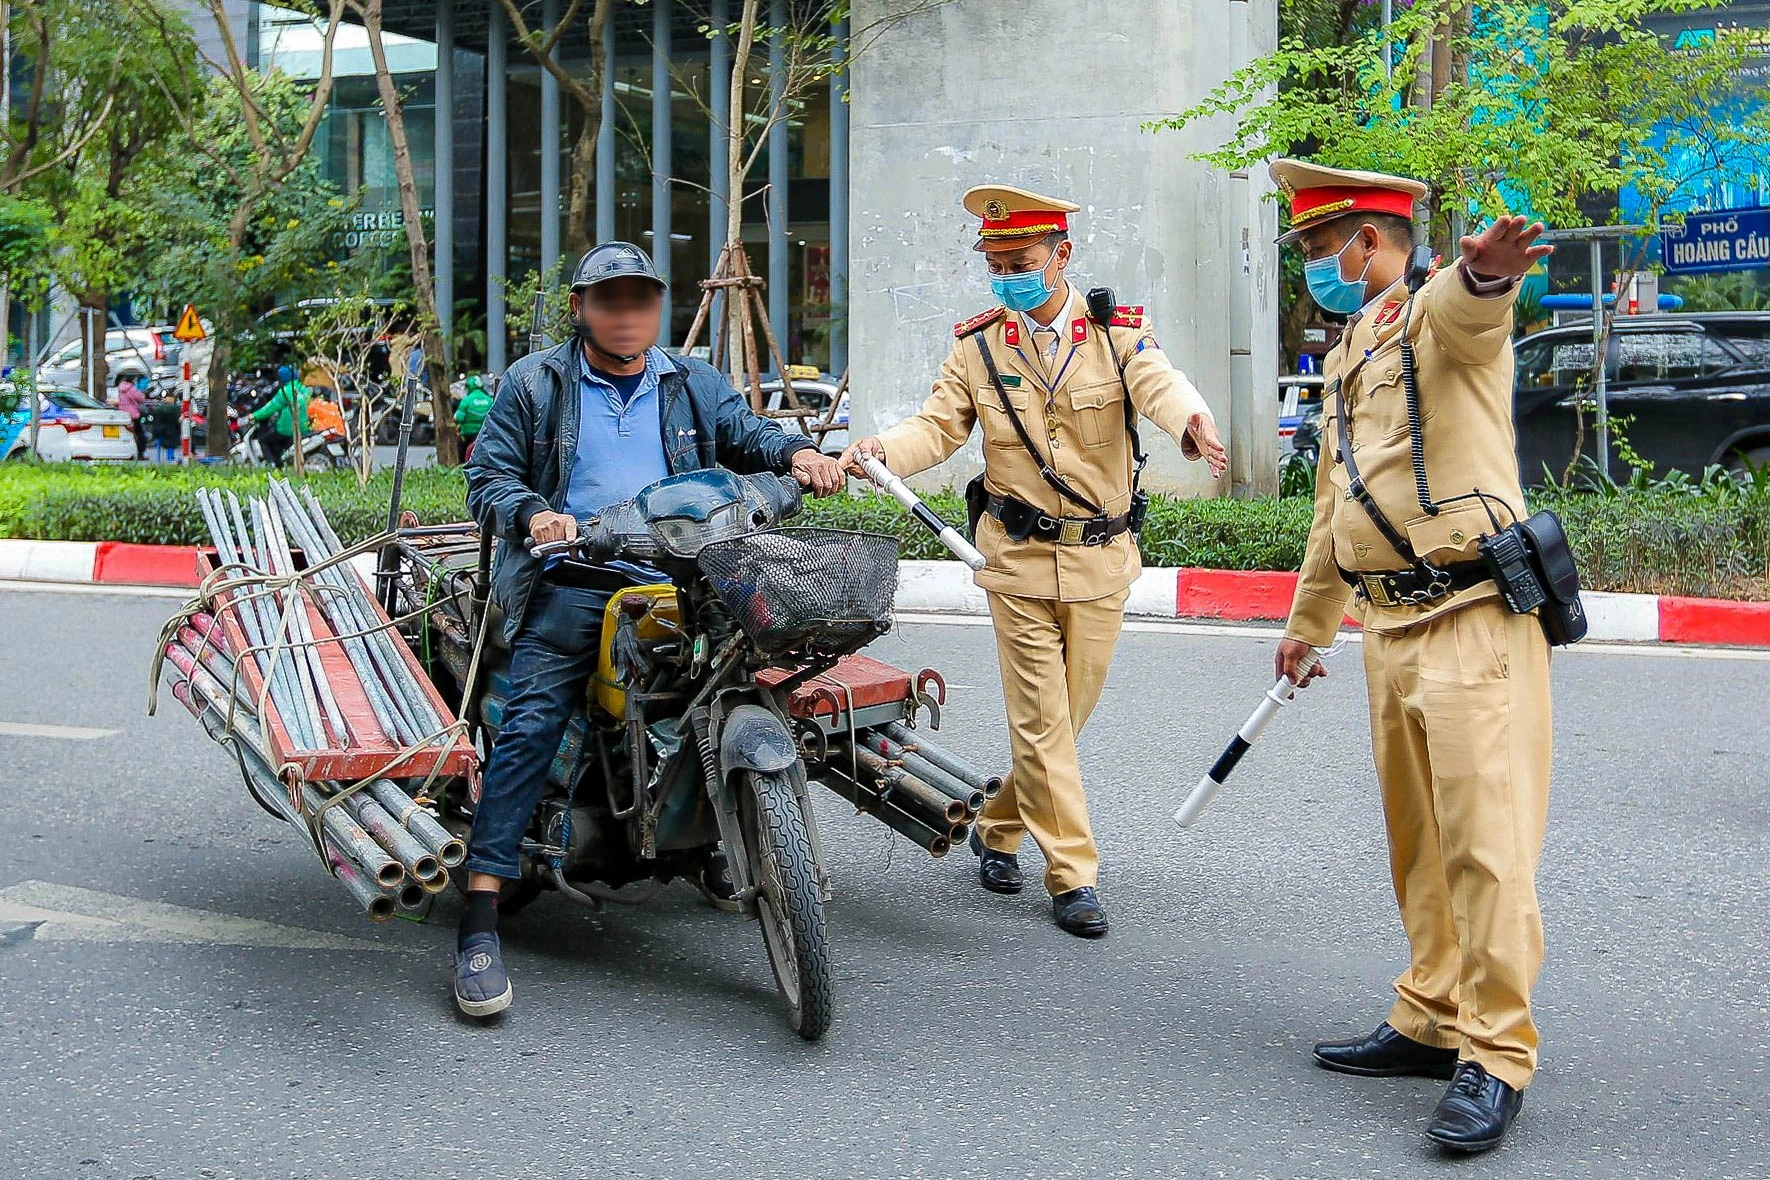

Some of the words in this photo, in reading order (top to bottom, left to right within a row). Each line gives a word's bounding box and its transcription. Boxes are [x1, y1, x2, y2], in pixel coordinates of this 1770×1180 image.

[1701, 215, 1739, 236] PHỐ
[1673, 236, 1731, 265] HOÀNG
[1734, 230, 1770, 260] CẦU
